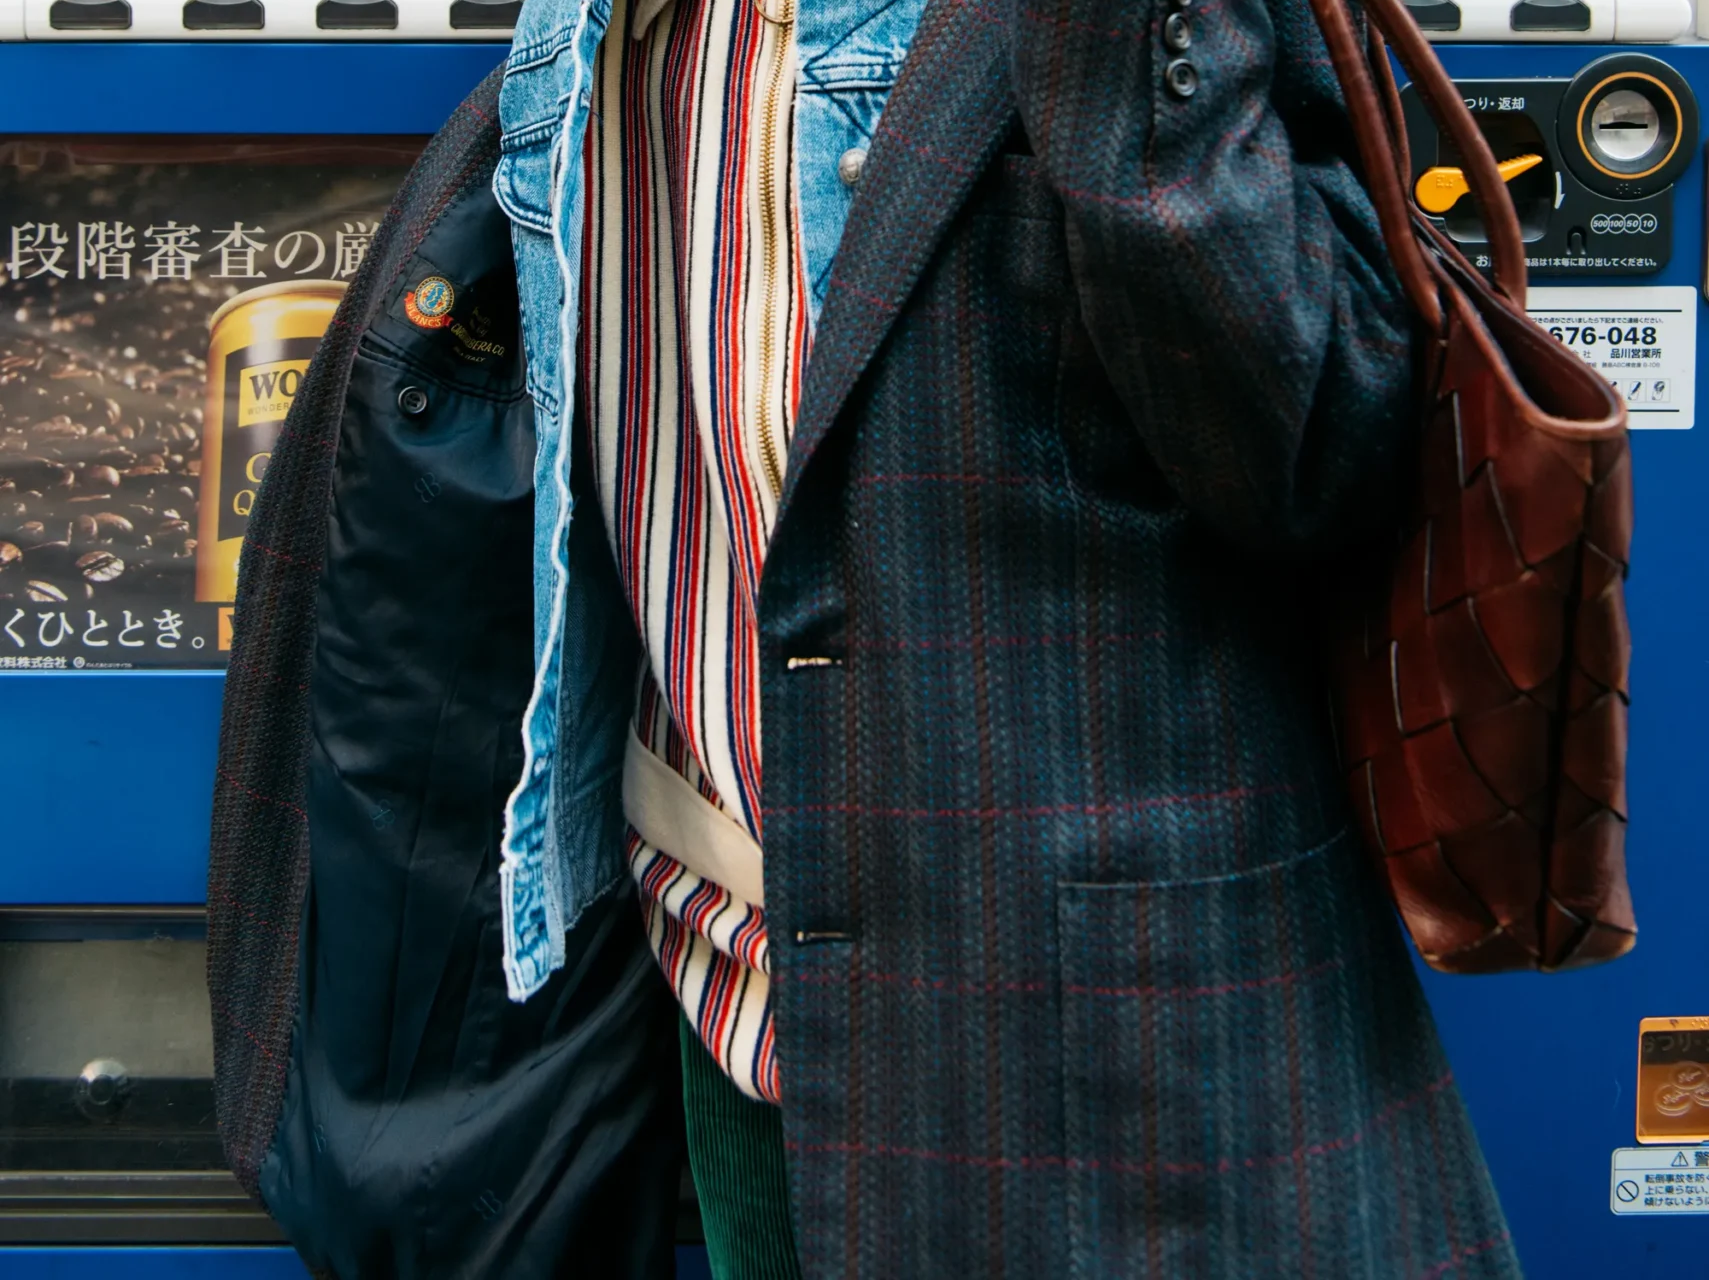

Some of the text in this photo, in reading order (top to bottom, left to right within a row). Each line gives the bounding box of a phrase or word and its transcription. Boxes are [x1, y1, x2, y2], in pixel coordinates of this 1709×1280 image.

[1593, 219, 1654, 228] 500 100 50 10
[1610, 348, 1662, 360] 品川営業所
[4, 608, 205, 650] くひととき。
